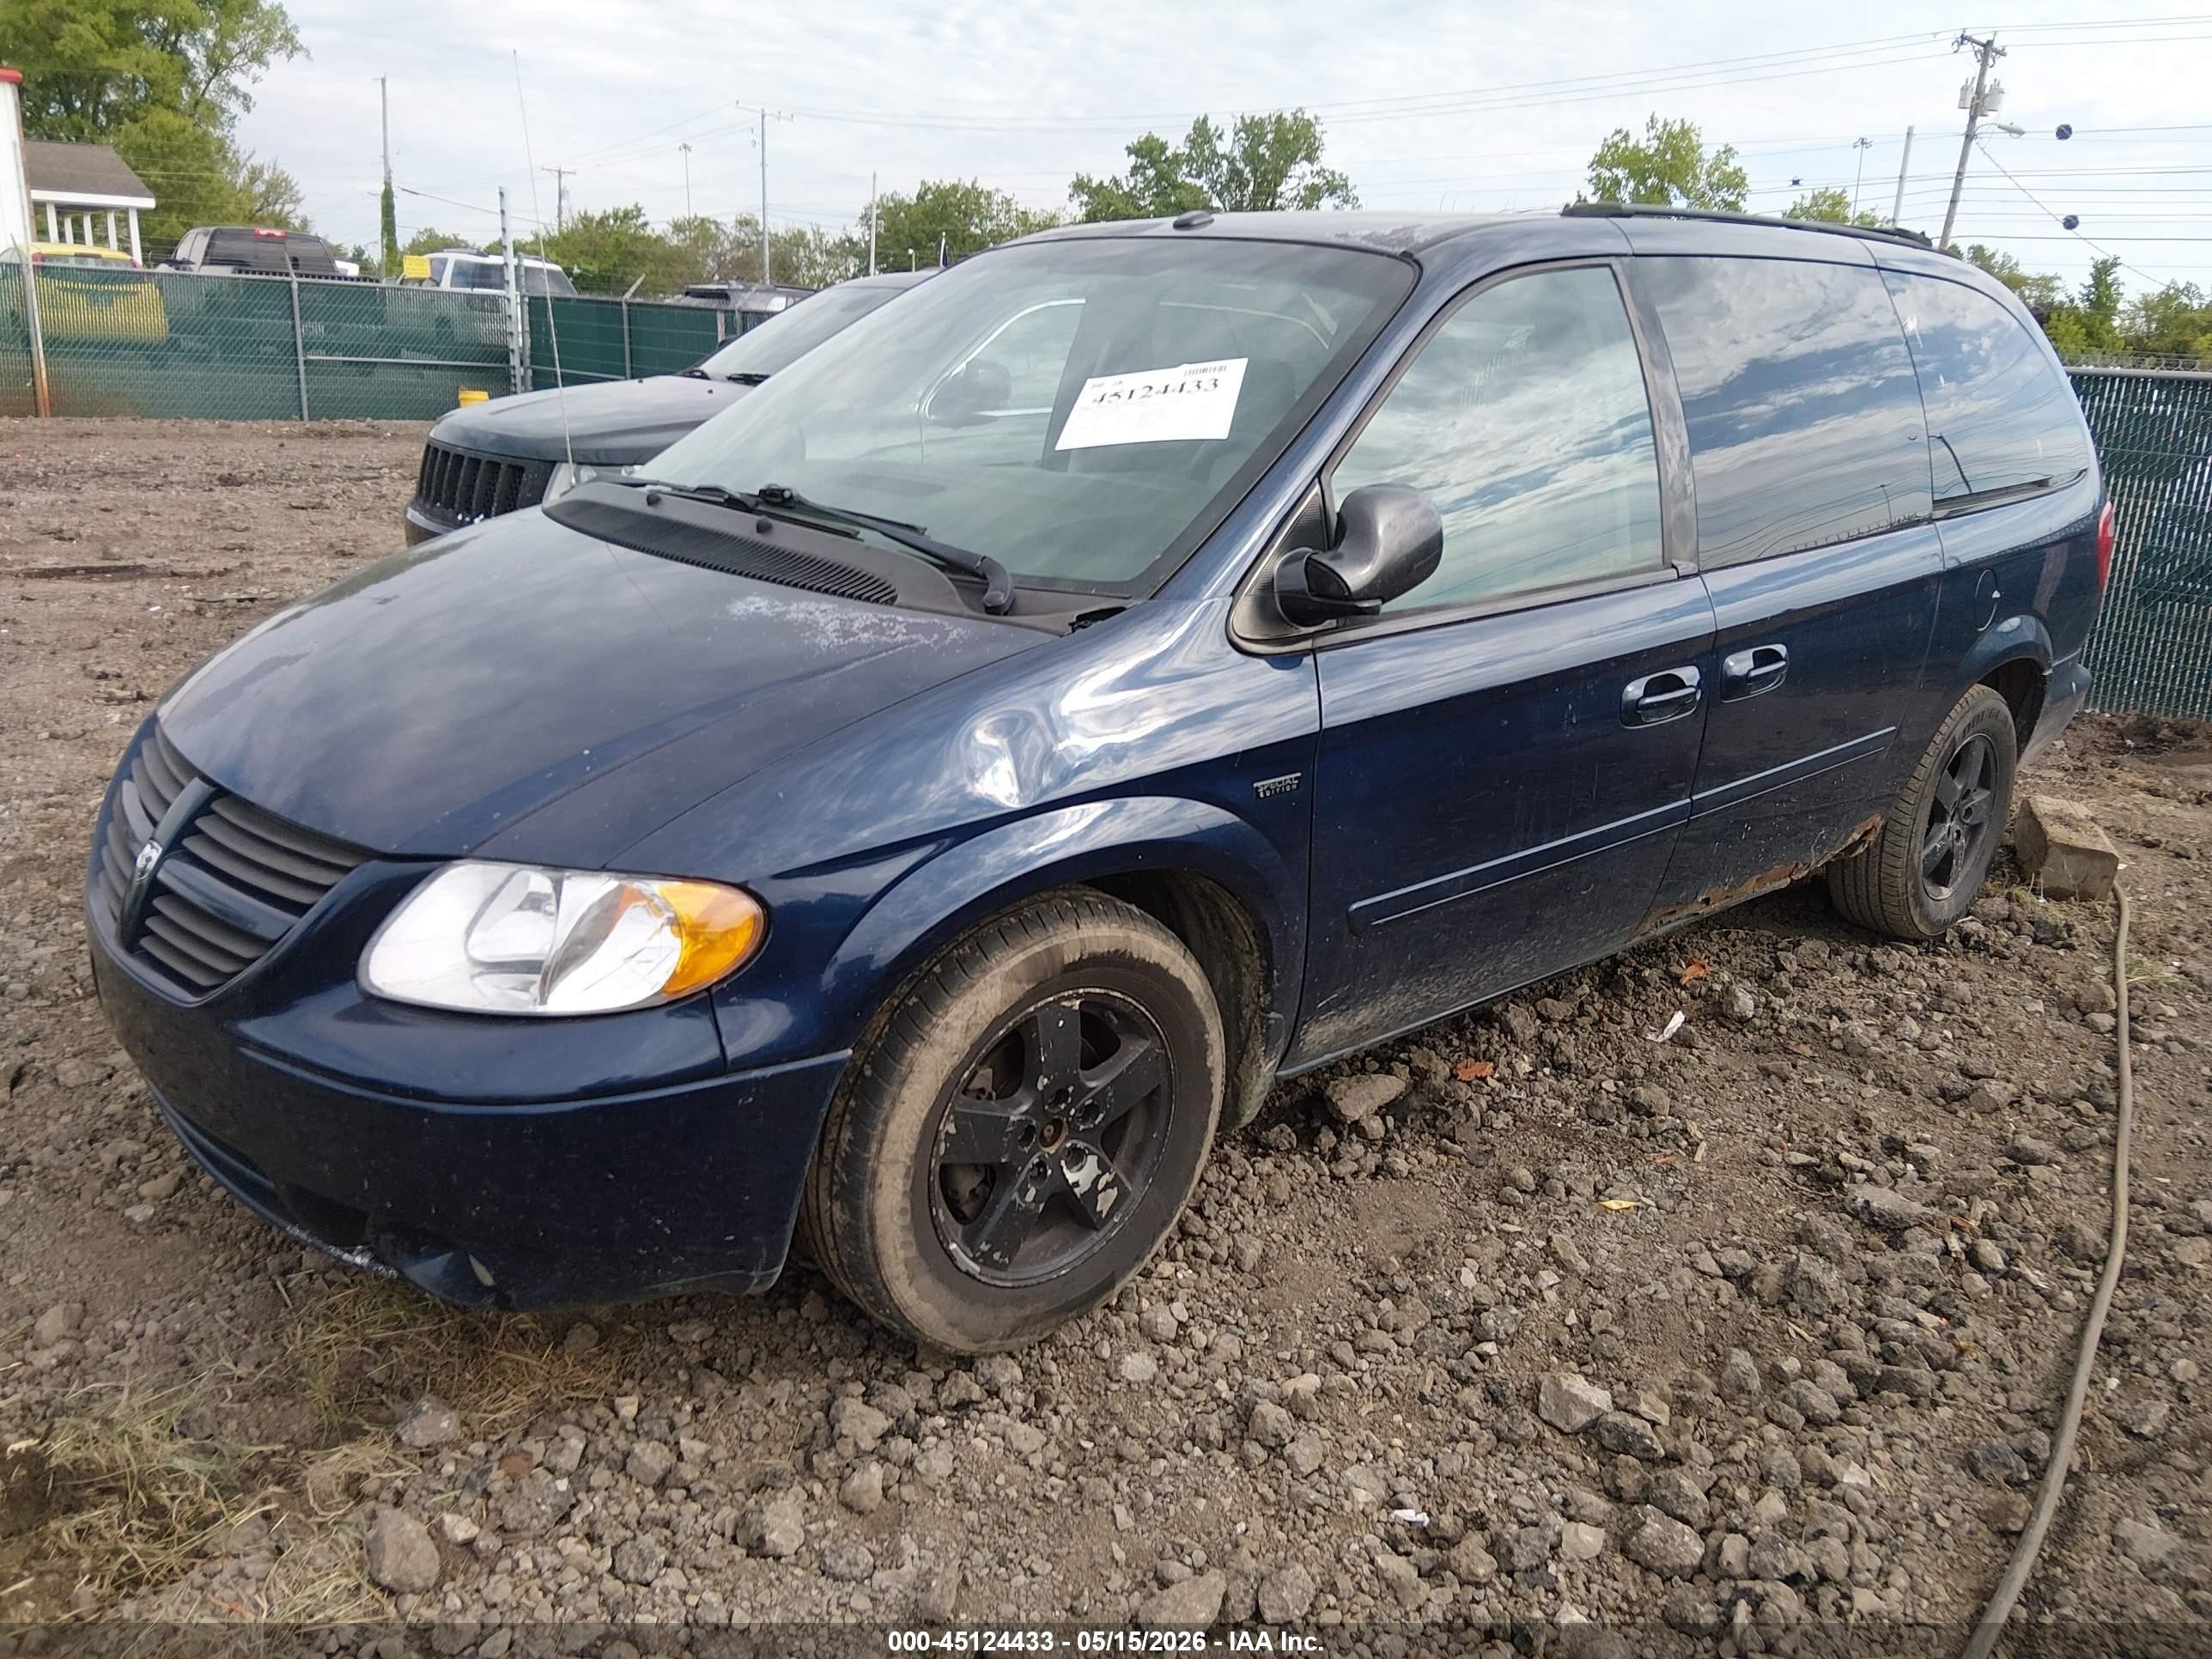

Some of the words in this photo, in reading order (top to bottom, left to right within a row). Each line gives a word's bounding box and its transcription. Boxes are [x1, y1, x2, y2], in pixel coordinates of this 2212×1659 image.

[1092, 378, 1219, 404] 45124433
[1257, 777, 1299, 792] SPECIAL
[1259, 783, 1297, 798] EDITION
